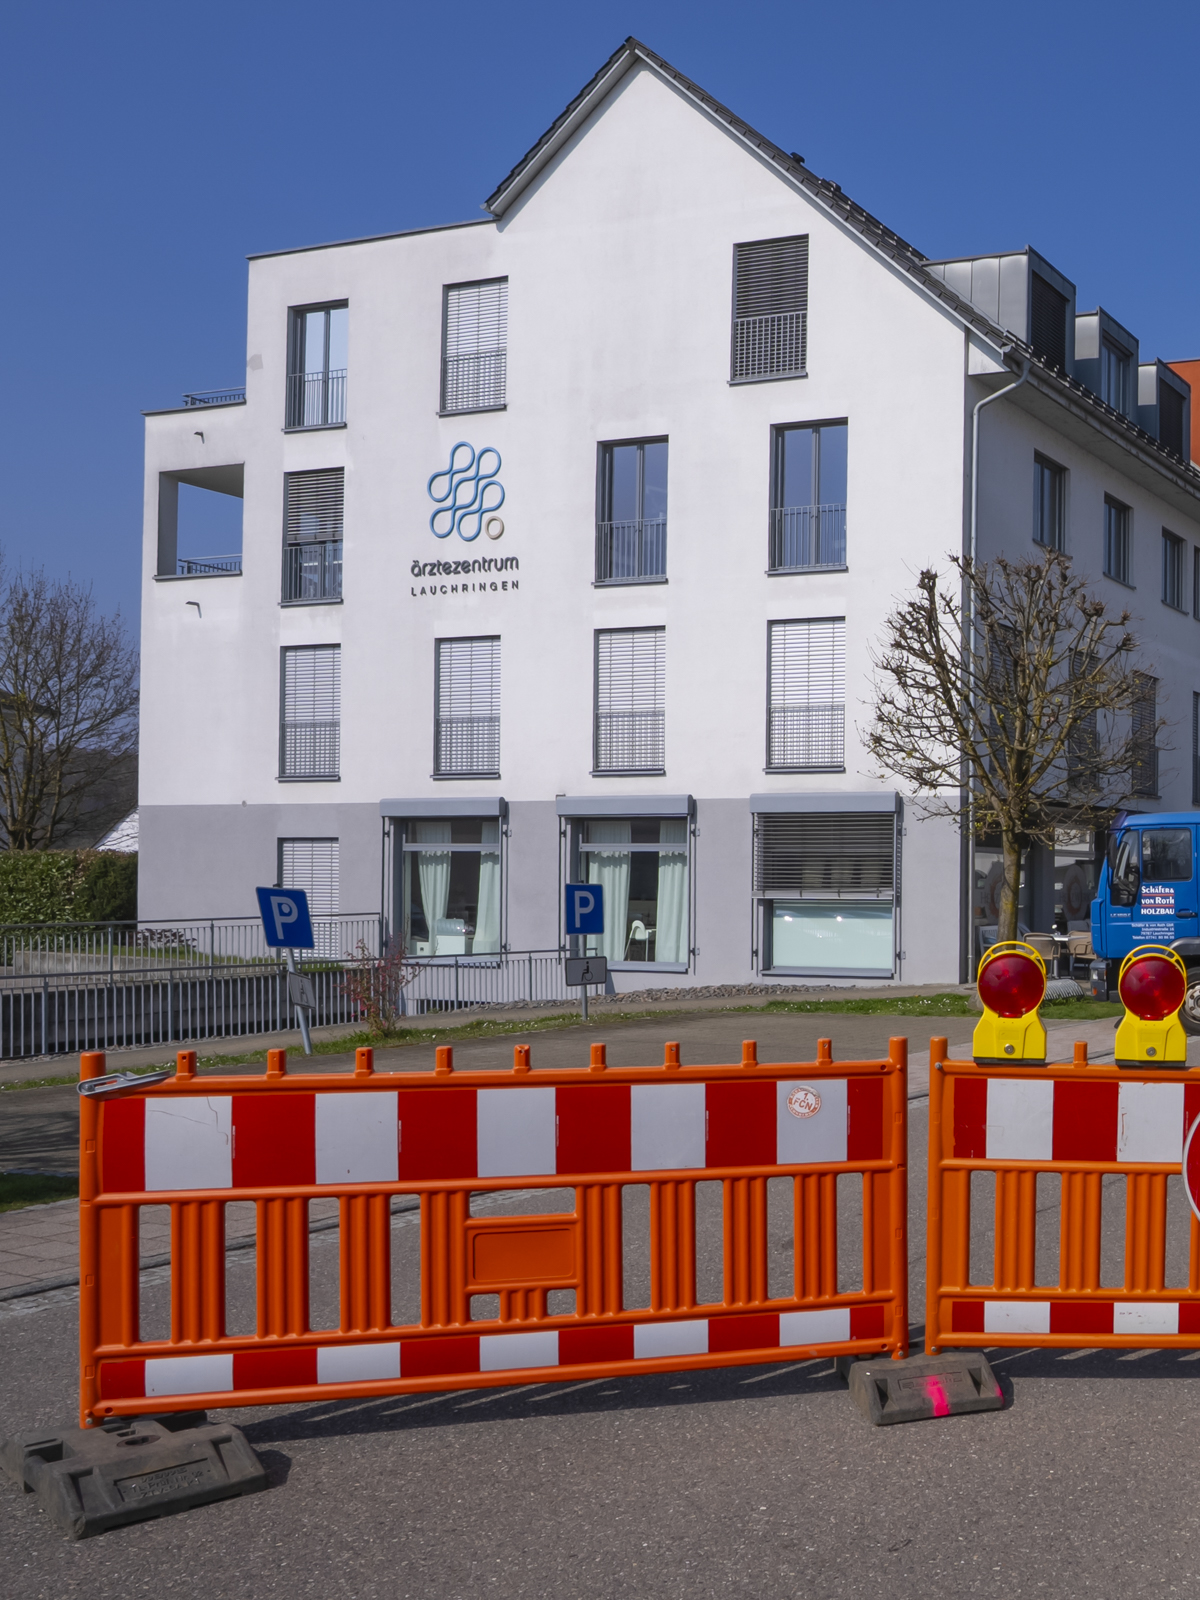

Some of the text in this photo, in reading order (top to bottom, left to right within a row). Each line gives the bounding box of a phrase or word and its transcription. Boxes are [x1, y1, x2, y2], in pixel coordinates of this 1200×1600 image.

[411, 557, 519, 577] ärztezentrum
[411, 580, 519, 597] LAUCHRINGEN
[270, 895, 298, 940] P
[574, 890, 594, 928] P
[793, 1097, 813, 1111] FCN
[803, 1092, 809, 1101] 1.
